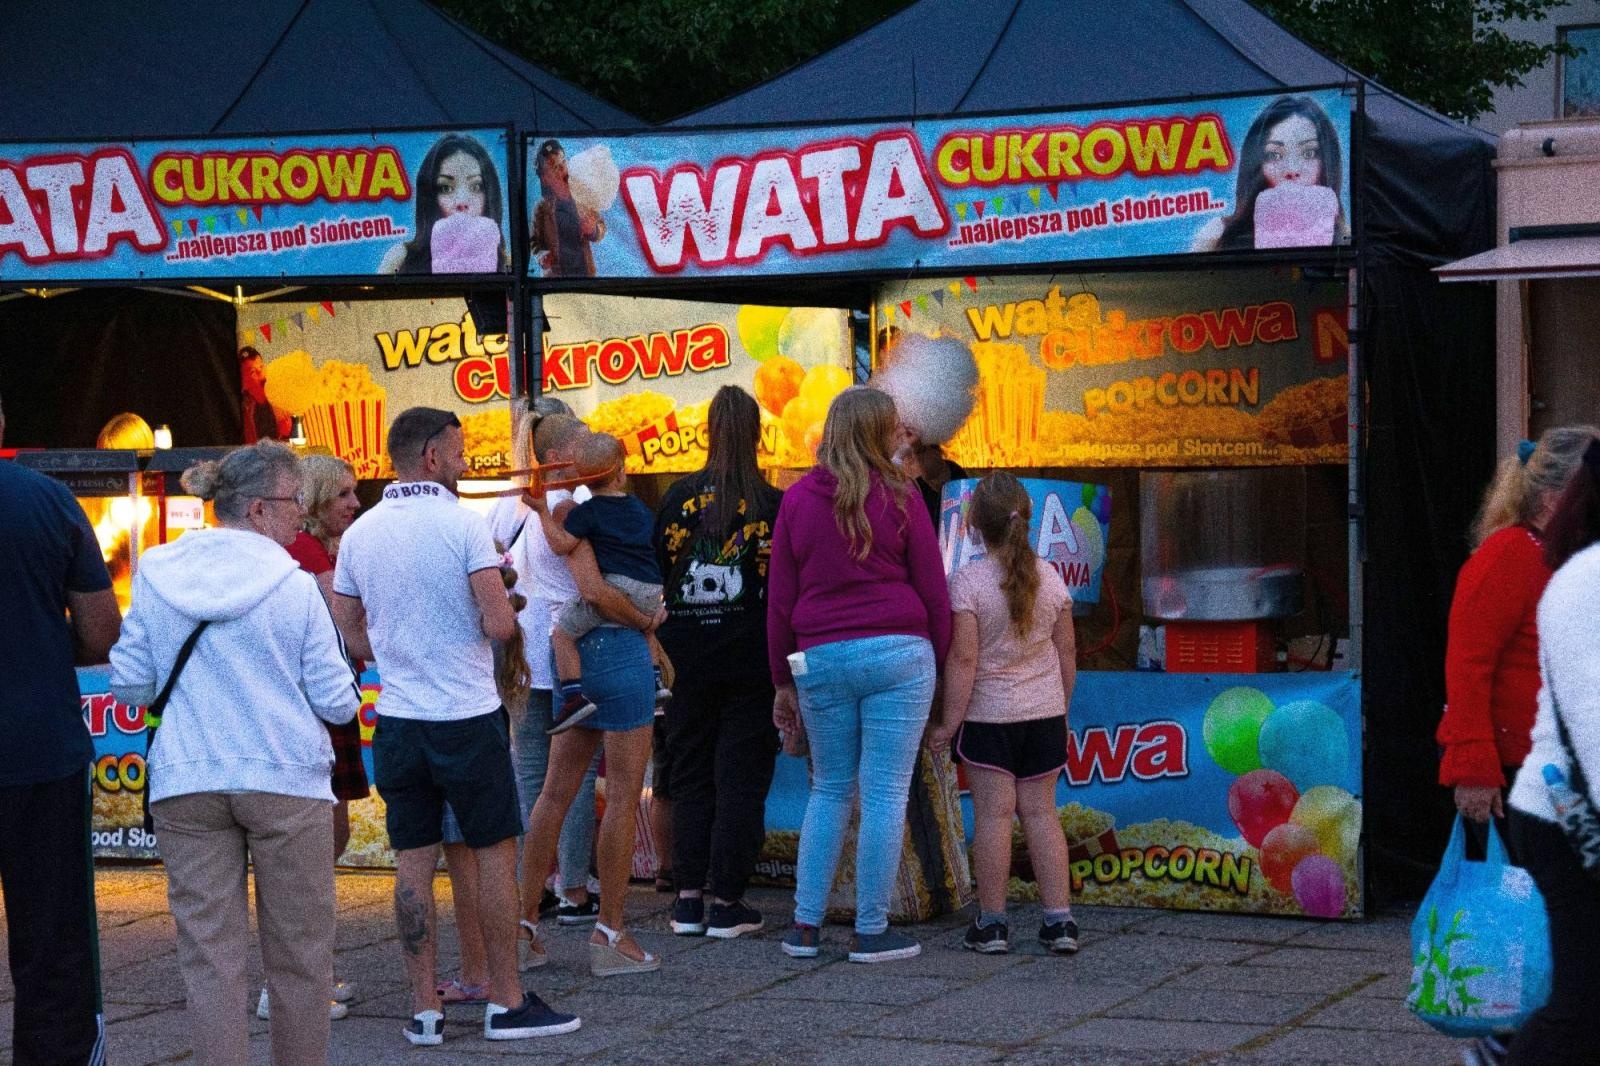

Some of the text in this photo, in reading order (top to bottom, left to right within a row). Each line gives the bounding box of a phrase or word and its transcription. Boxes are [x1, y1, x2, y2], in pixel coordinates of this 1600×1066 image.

[938, 120, 1229, 184] CUKROWA
[152, 152, 407, 204] CUKROWA
[626, 136, 945, 268] WATA
[271, 225, 307, 251] pod
[1067, 207, 1108, 229] pod
[1085, 366, 1260, 420] POPCORN
[474, 451, 501, 470] pod
[401, 484, 439, 497] BOSS
[1069, 845, 1252, 893] POPCORN
